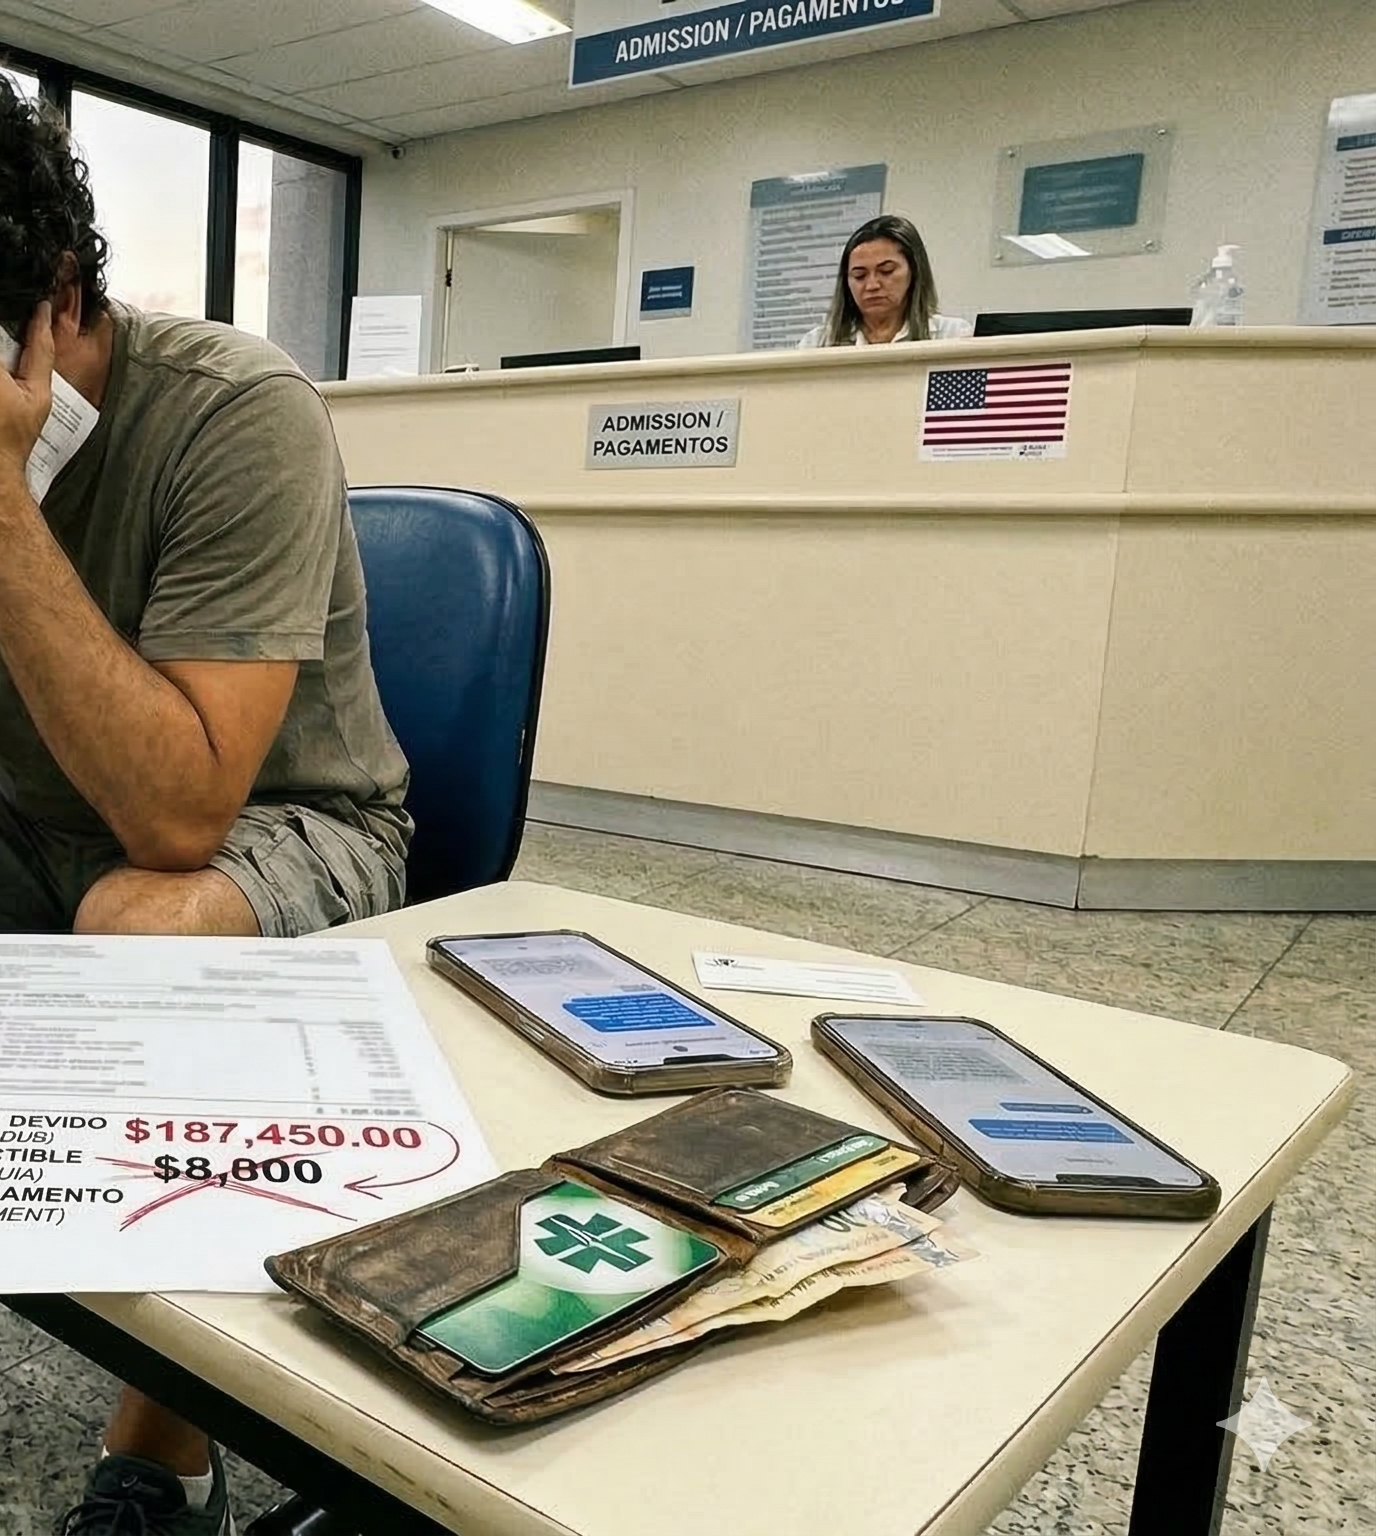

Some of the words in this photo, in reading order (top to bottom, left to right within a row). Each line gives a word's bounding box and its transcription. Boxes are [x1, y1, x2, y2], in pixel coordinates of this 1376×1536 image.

[615, 18, 729, 63] ADMISSION
[735, 14, 746, 38] /
[749, 0, 905, 35] PAGAMEN
[601, 412, 711, 432] ADMISSION
[716, 411, 724, 427] /
[593, 436, 728, 456] PAGAMENTOS
[9, 1115, 108, 1129] DEVIDO
[124, 1117, 423, 1148] $187,450.00
